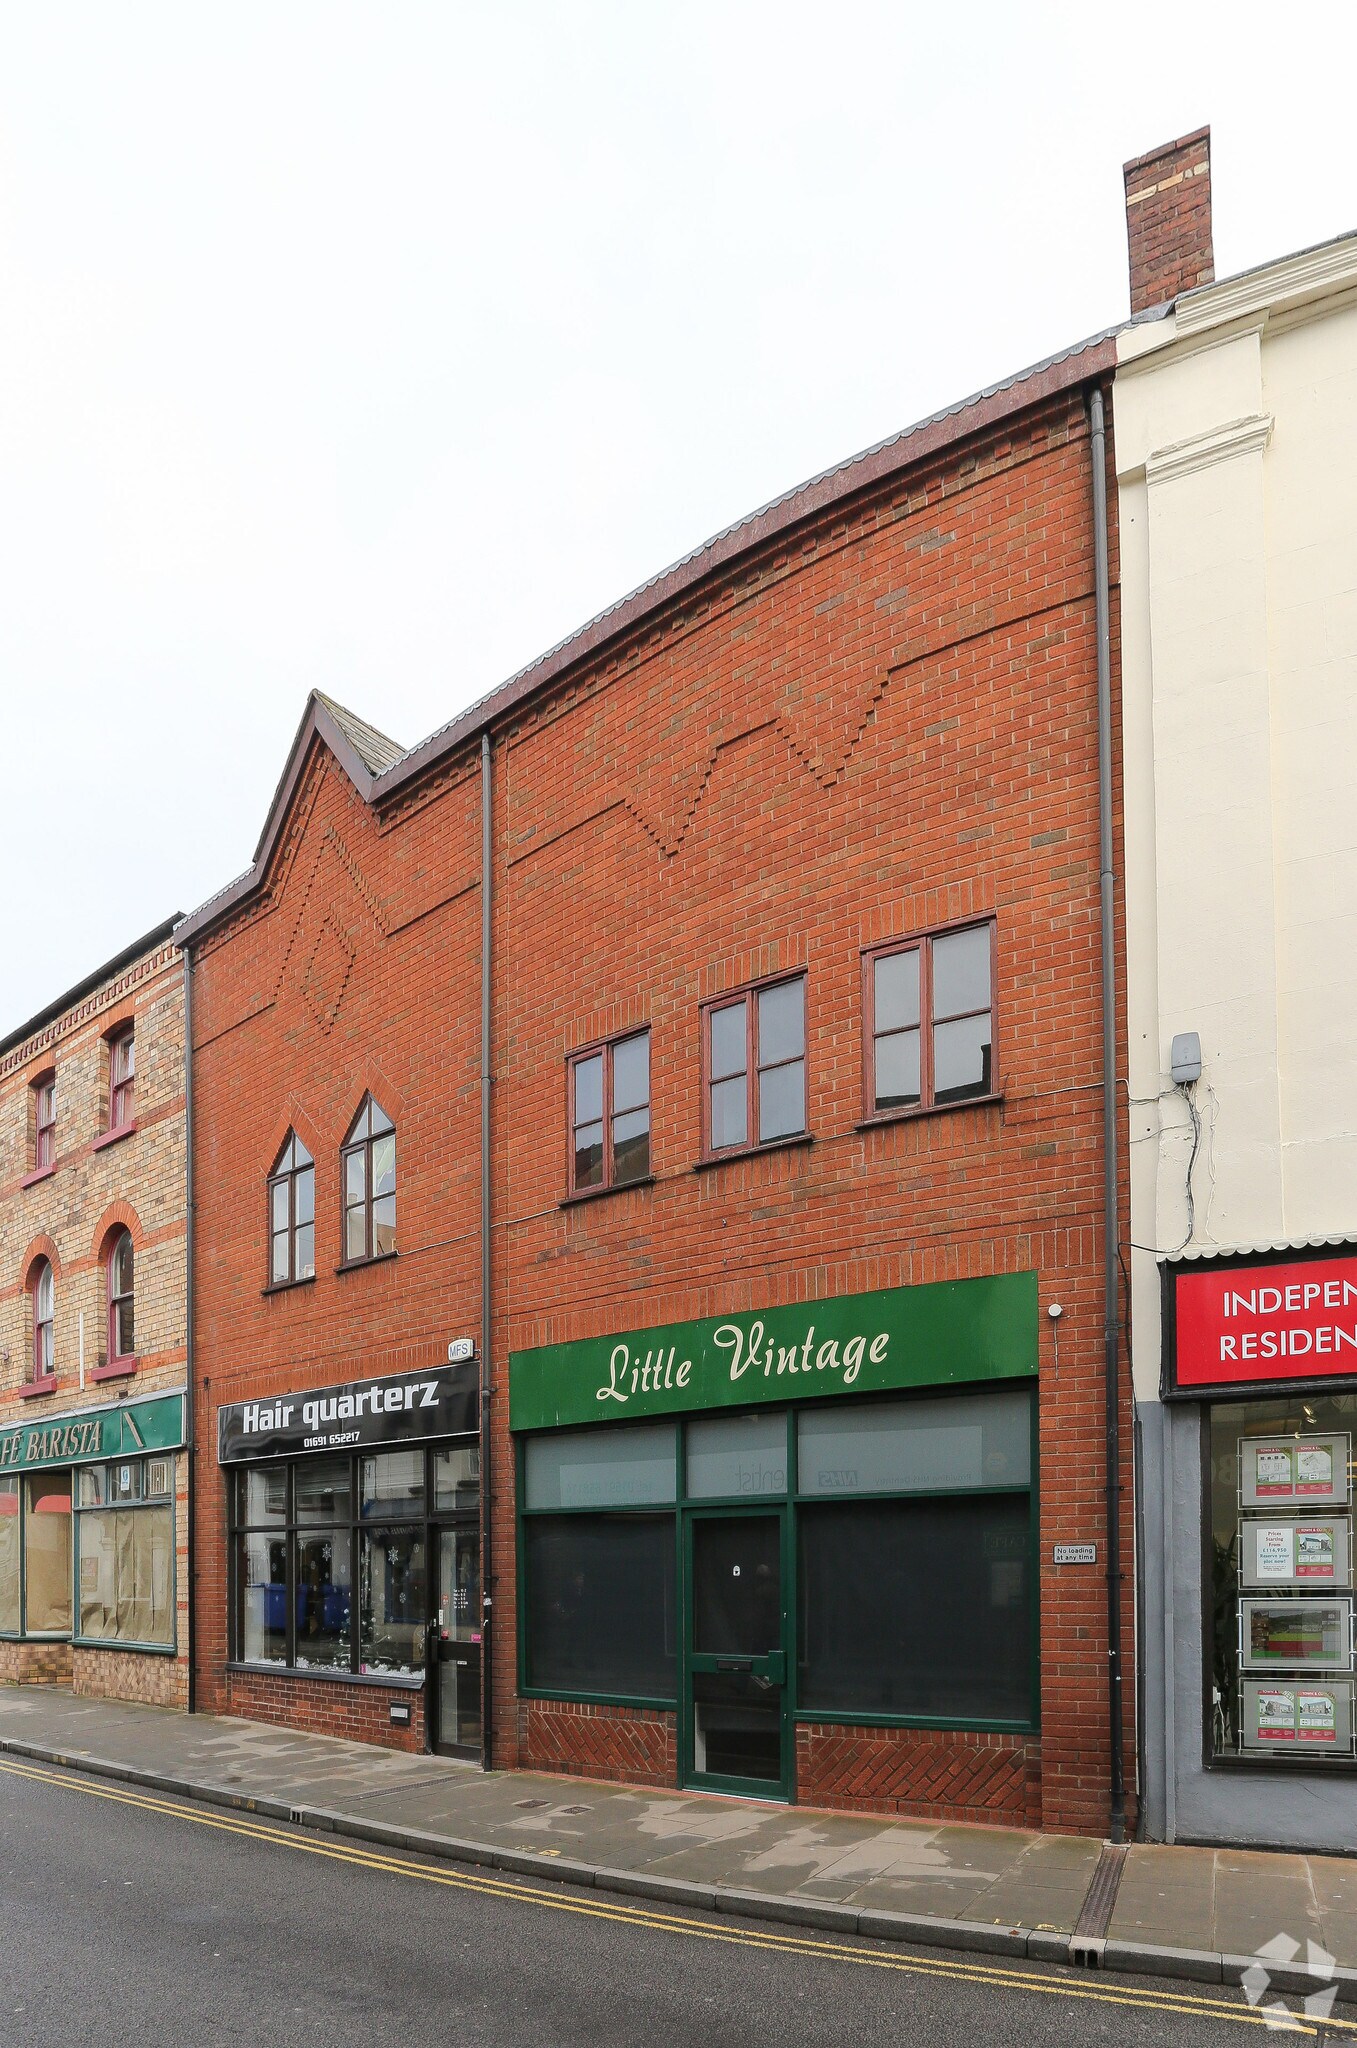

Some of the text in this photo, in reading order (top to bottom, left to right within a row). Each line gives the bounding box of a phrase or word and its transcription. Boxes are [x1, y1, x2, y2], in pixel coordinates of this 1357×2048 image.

[1222, 1279, 1357, 1317] INDEPEN
[450, 1343, 468, 1357] MFS
[596, 1320, 890, 1402] Little Vintage
[1219, 1324, 1357, 1361] RESIDEN
[243, 1381, 440, 1434] Hair quarterz
[25, 1420, 102, 1461] BARISTA
[303, 1431, 360, 1448] 01691 652217
